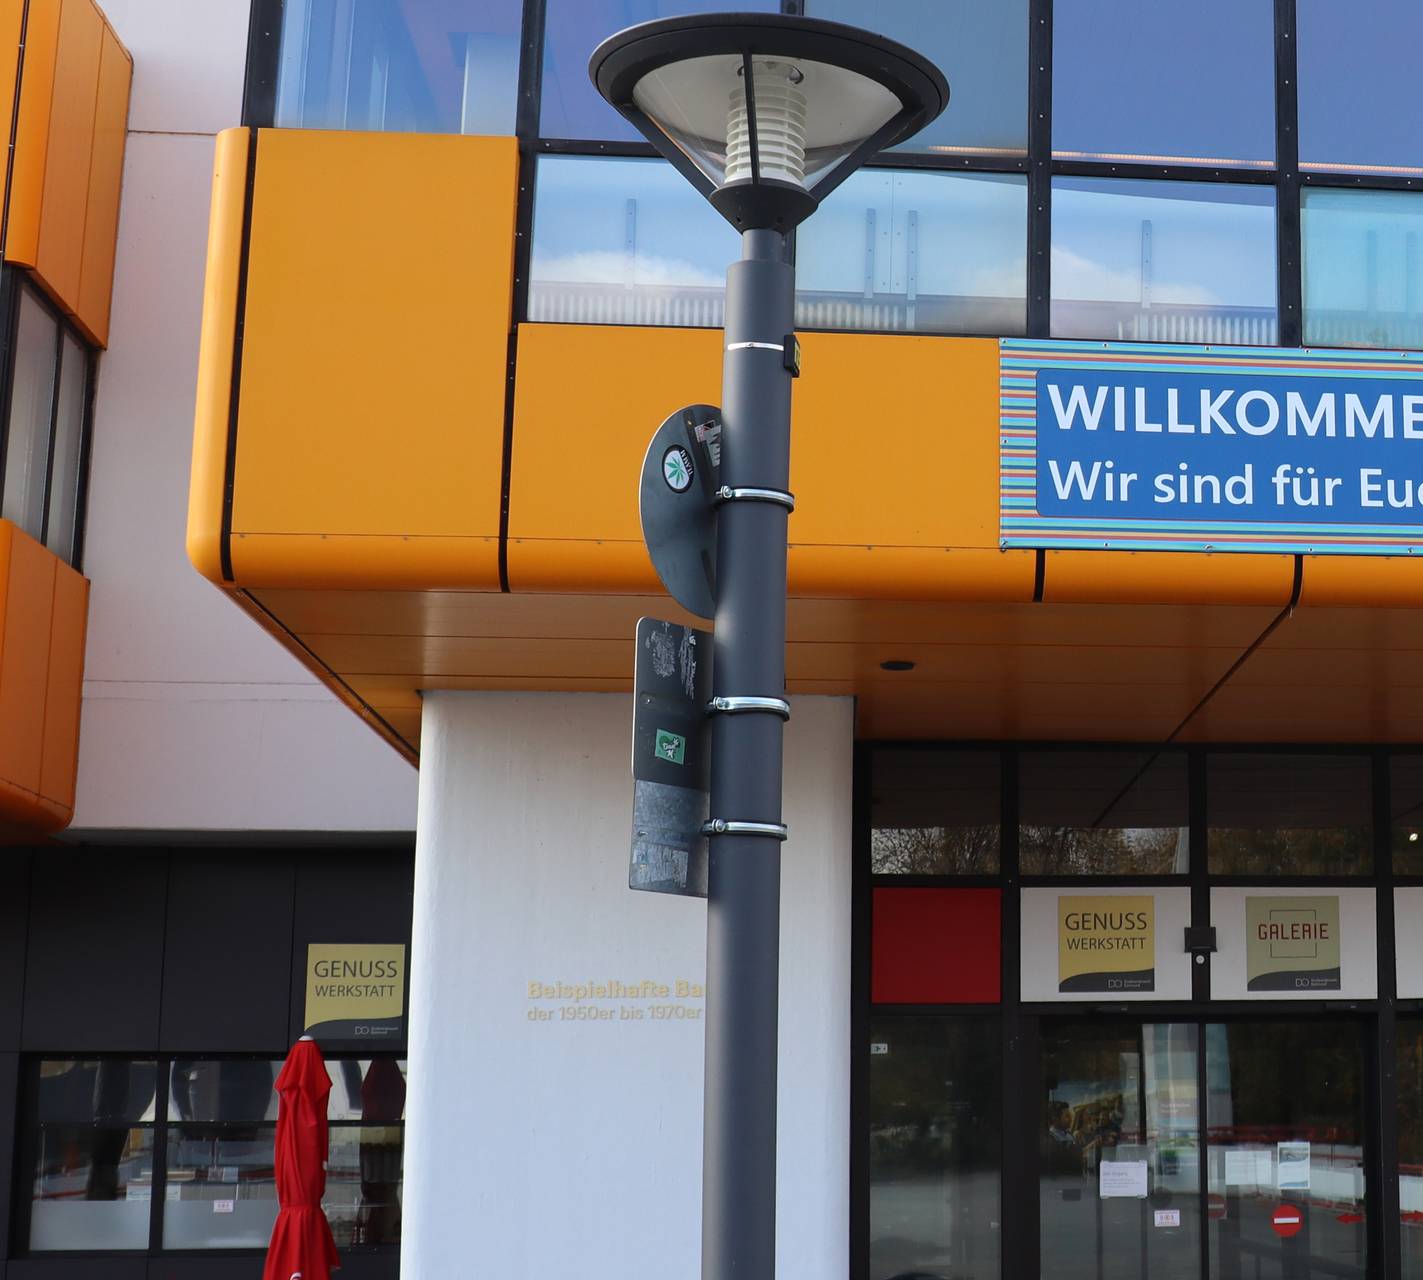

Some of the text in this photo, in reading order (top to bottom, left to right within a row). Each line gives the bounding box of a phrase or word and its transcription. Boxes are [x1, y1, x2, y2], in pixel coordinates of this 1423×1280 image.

[1048, 460, 1138, 502] Wir
[1154, 462, 1253, 505] sind
[1272, 464, 1342, 506] für
[1065, 912, 1147, 931] GENUSS
[1257, 923, 1329, 940] GALERIE
[1067, 937, 1147, 951] WERKSTATT
[314, 960, 398, 978] GENUSS
[315, 985, 396, 998] WERKSTATT
[527, 978, 705, 1002] Beispielhafte Ba
[527, 1006, 555, 1020] der
[620, 1005, 644, 1020] bis
